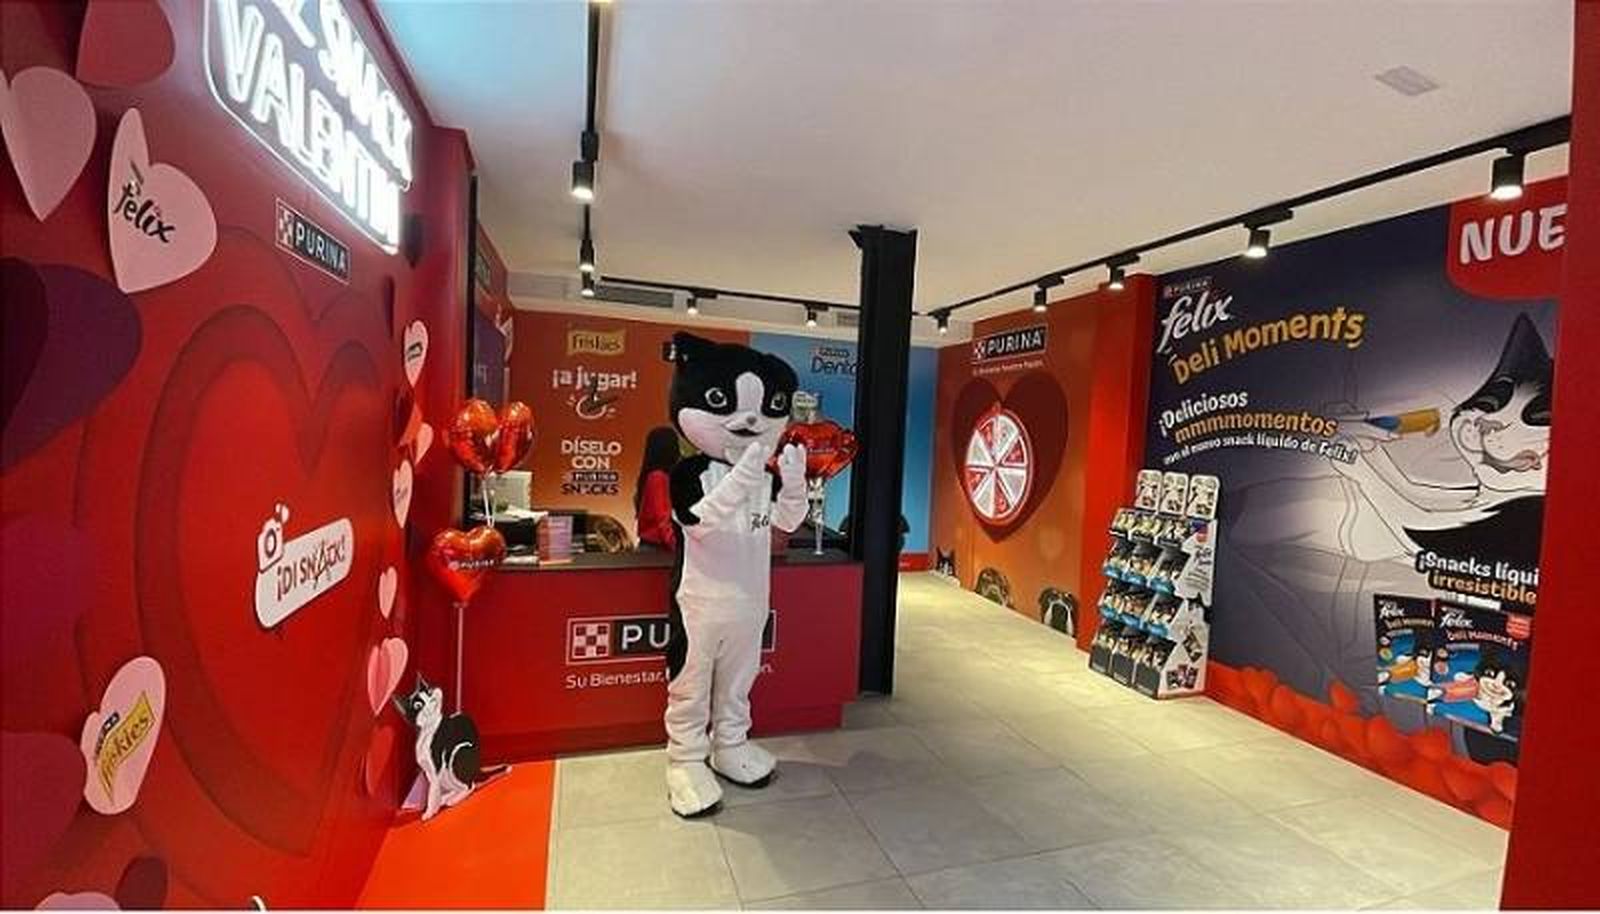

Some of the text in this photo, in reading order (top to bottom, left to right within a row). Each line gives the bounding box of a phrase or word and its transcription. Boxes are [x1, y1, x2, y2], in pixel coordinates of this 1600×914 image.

[296, 222, 347, 273] PURINA
[1459, 203, 1568, 265] NUE
[987, 329, 1043, 355] PURINA
[1173, 307, 1364, 384] Deli Moments
[576, 365, 637, 391] jugar!
[1159, 391, 1248, 437] ¡Deliciosos
[561, 436, 622, 456] DÍSELO
[572, 456, 610, 470] CON
[1418, 551, 1539, 586] ¡Snacks líqui
[1433, 571, 1537, 604] irresistible
[565, 674, 588, 689] Su
